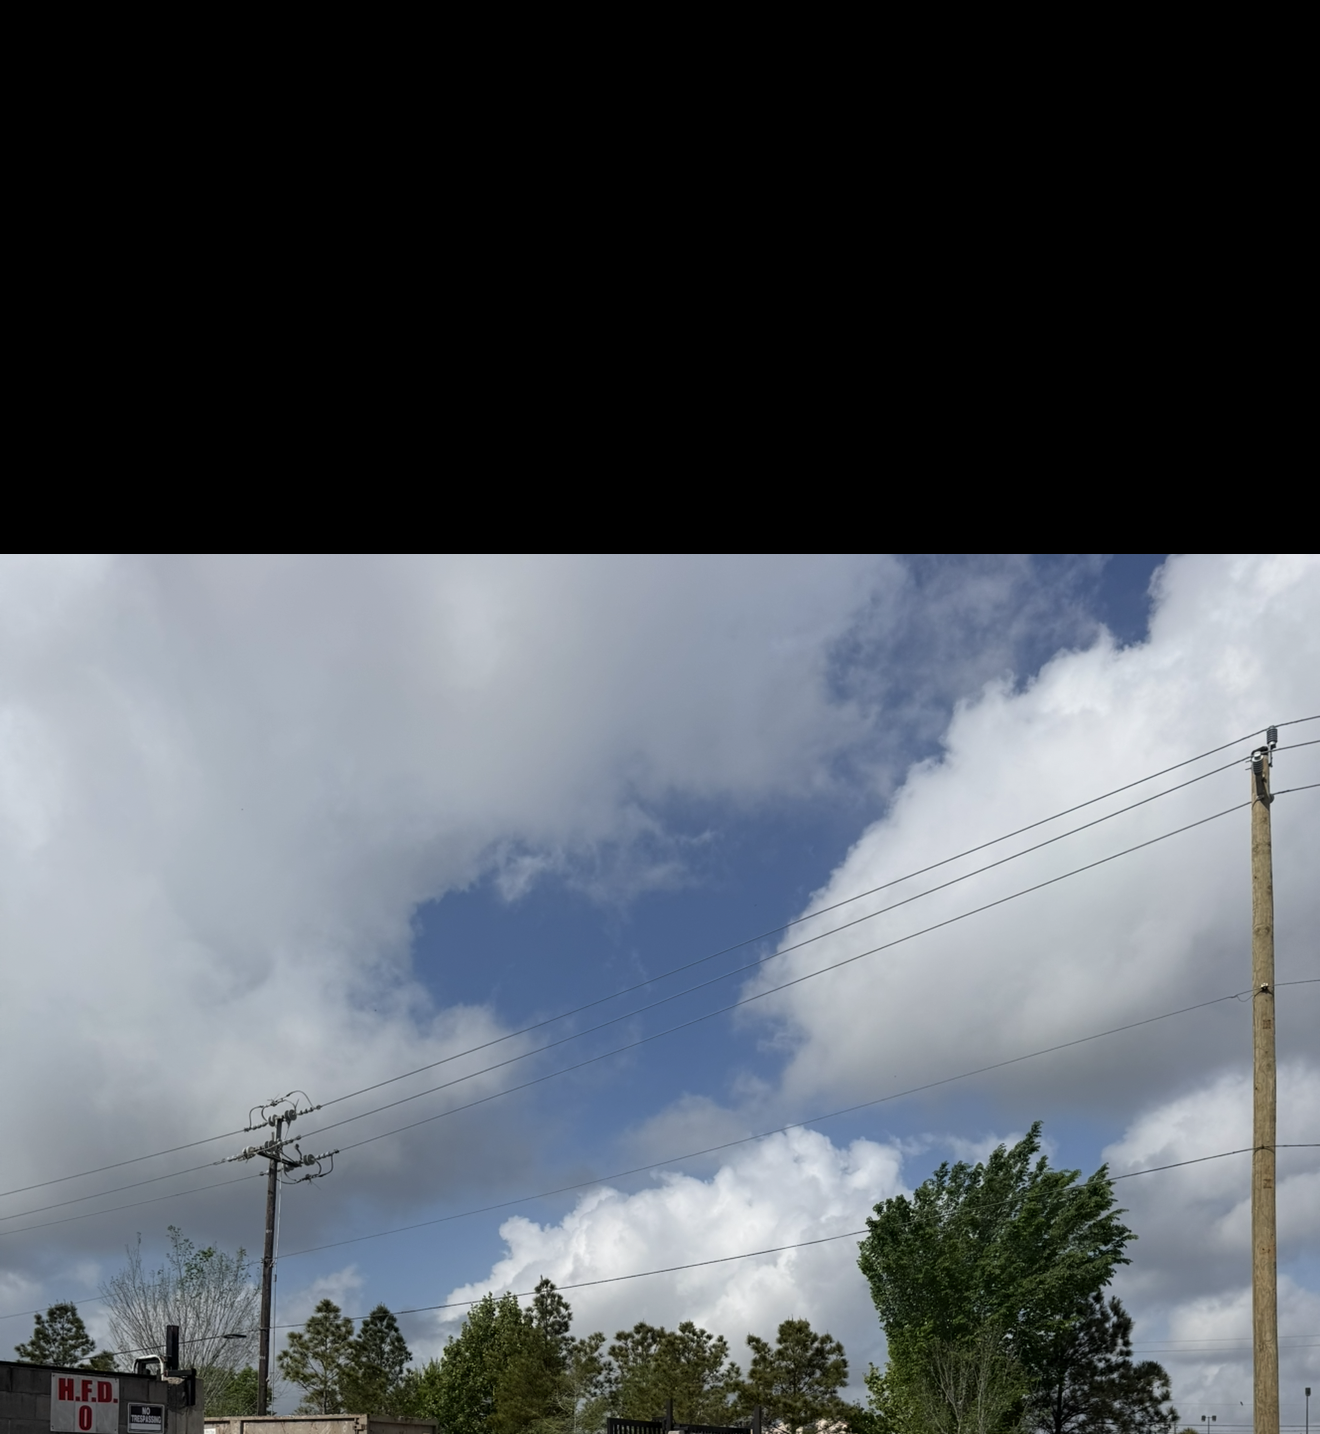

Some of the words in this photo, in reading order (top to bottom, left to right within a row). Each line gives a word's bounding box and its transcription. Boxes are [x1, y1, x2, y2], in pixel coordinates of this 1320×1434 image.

[58, 1378, 118, 1403] H.F.D.
[141, 1407, 151, 1415] NO
[131, 1414, 161, 1424] TRESPASSING
